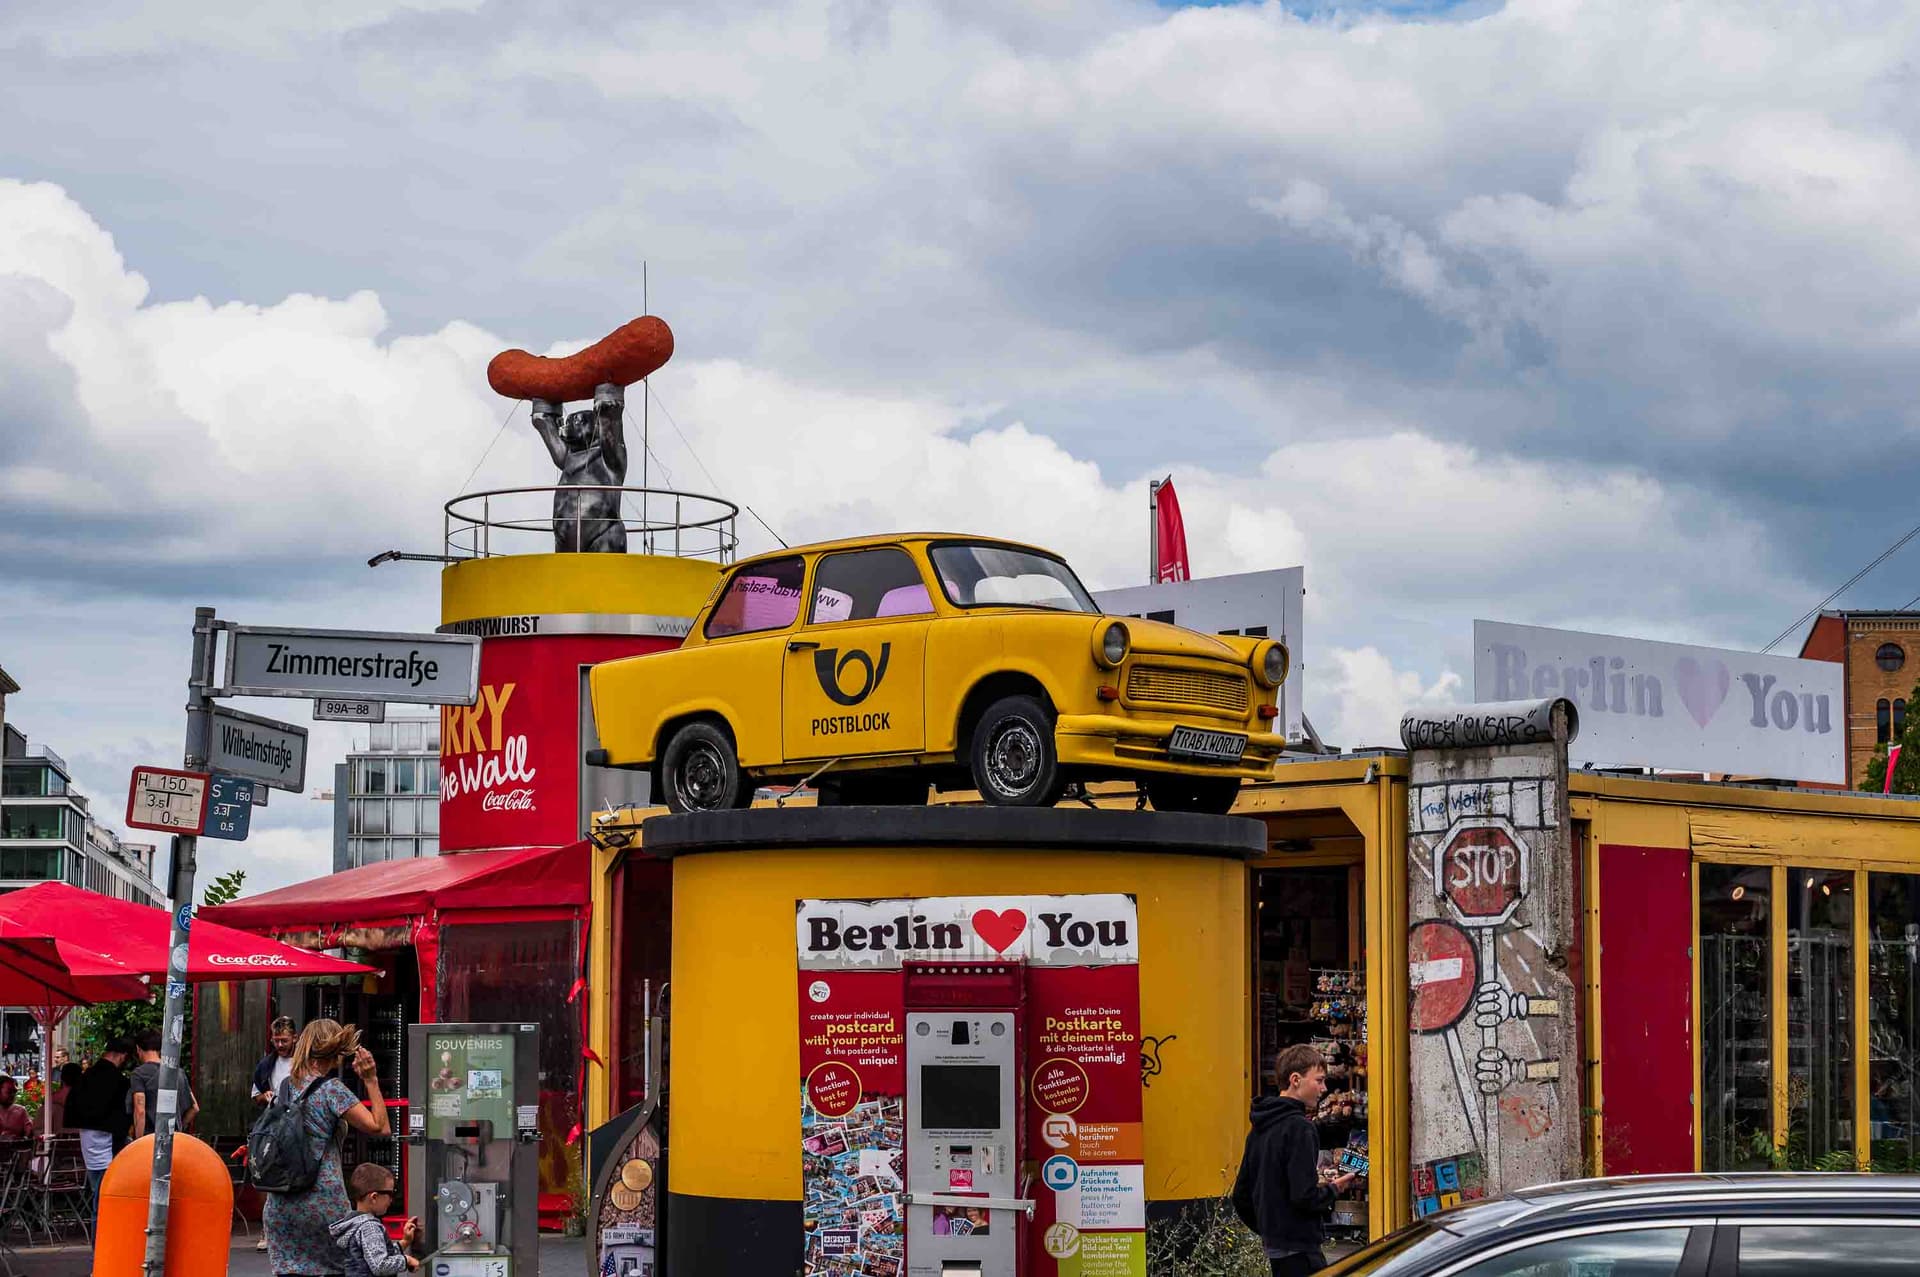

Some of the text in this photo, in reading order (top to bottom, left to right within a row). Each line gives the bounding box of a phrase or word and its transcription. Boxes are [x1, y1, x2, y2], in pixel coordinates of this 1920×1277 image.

[454, 616, 540, 636] CURRYWURST
[266, 644, 438, 687] Zimmerstraße
[1491, 642, 1831, 735] Berlin You
[812, 712, 890, 737] POSTBLOCK
[223, 724, 292, 774] Wilhelmstraße
[459, 734, 536, 794] Wall
[138, 774, 187, 792] H 150
[211, 784, 222, 798] S
[235, 791, 251, 801] 150
[1450, 845, 1516, 888] STOP
[807, 913, 1129, 952] Berlin You
[854, 1011, 890, 1019] individual
[1065, 1008, 1097, 1016] Gestalte
[826, 1018, 894, 1037] postcard
[1046, 1016, 1122, 1031] Postkarte
[805, 1035, 829, 1045] with
[832, 1038, 857, 1048] your
[1040, 1031, 1134, 1043] mit deinem Foto
[435, 1039, 503, 1050] SOUVENIRS
[825, 1047, 831, 1055] &
[847, 1047, 880, 1056] postcard
[1067, 1044, 1103, 1052] Postkarte
[859, 1055, 897, 1067] unique!
[1078, 1052, 1126, 1064] einmalig!
[824, 1071, 836, 1083] All
[1048, 1069, 1064, 1080] Alle
[815, 1079, 850, 1094] functions
[1038, 1075, 1081, 1091] Funktionen
[1079, 1125, 1119, 1133] Bildschirm
